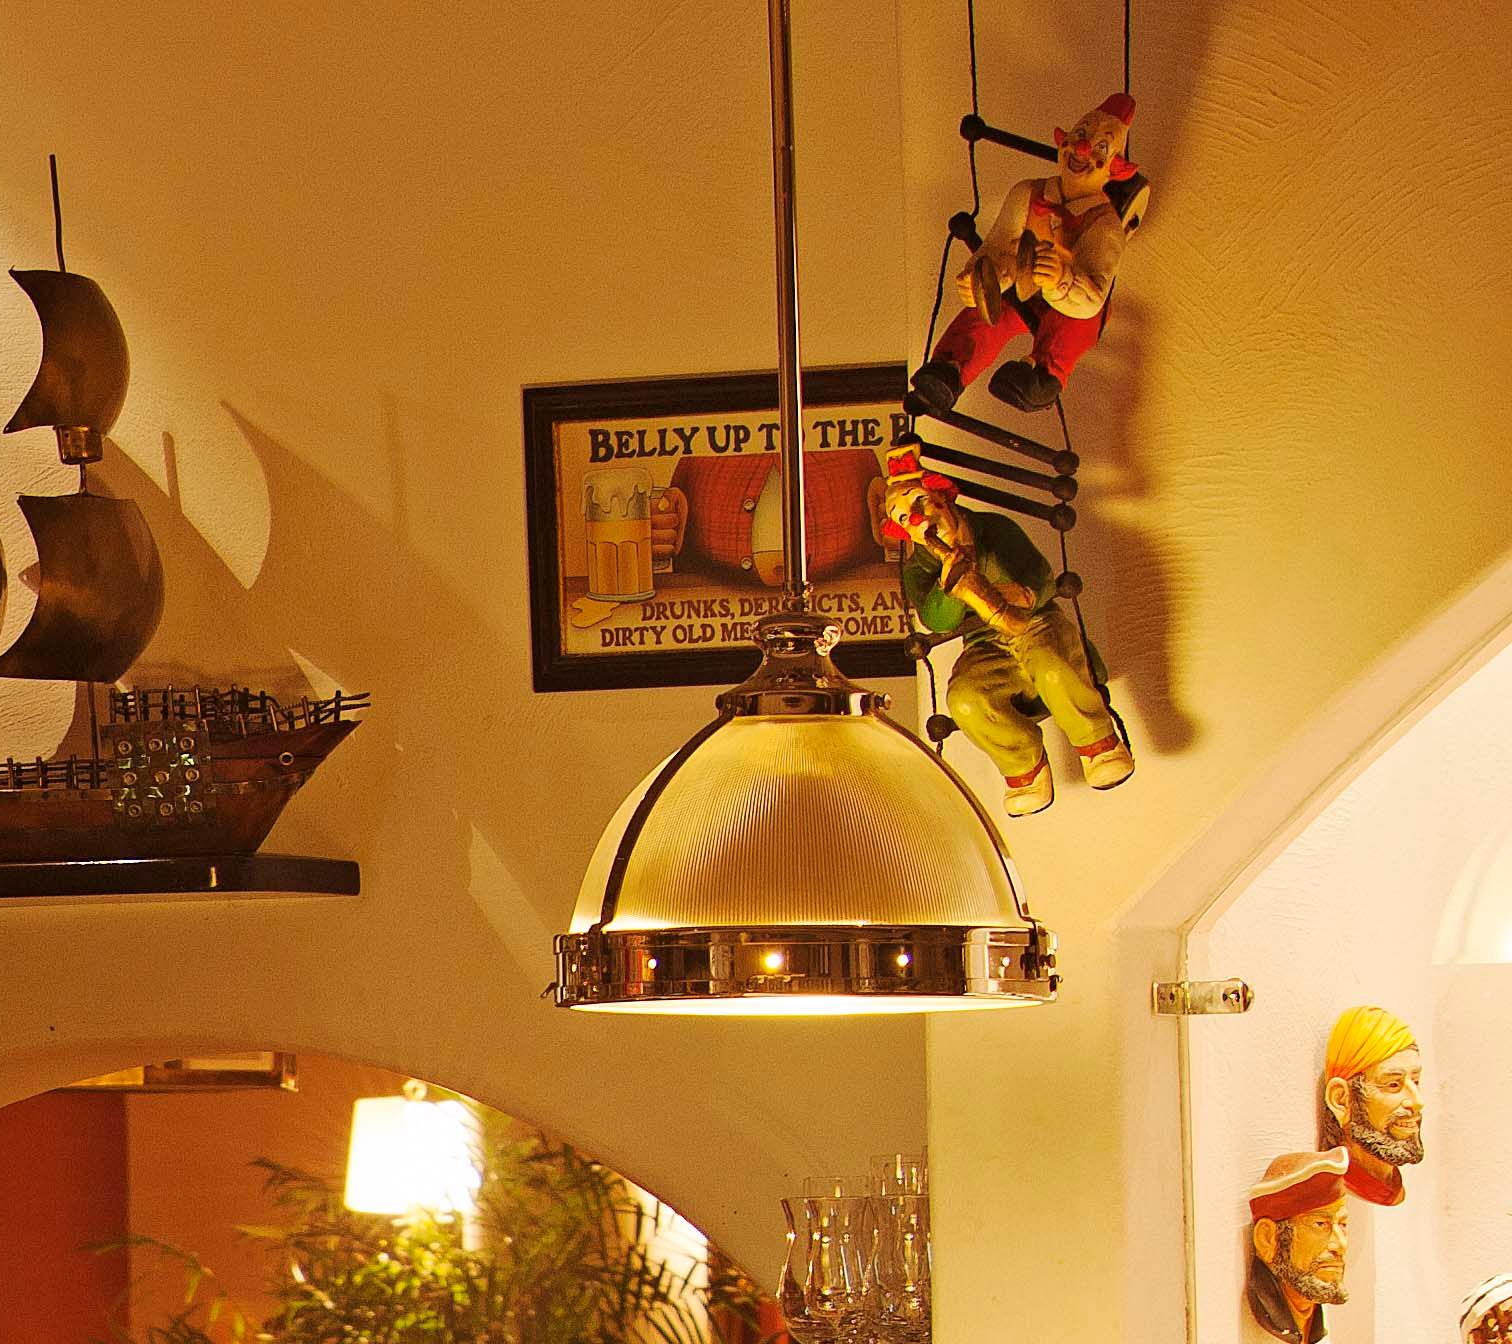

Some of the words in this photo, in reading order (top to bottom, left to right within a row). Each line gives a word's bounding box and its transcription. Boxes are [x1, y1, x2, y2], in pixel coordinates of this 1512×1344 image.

[588, 427, 700, 463] BELLY
[706, 423, 752, 453] UP
[758, 423, 780, 450] T
[812, 418, 883, 449] THE
[641, 597, 735, 622] DRUNKS,
[740, 592, 864, 617] DERICTS,
[601, 624, 666, 647] DIRTY
[672, 620, 715, 643] OLD
[721, 619, 760, 641] ME
